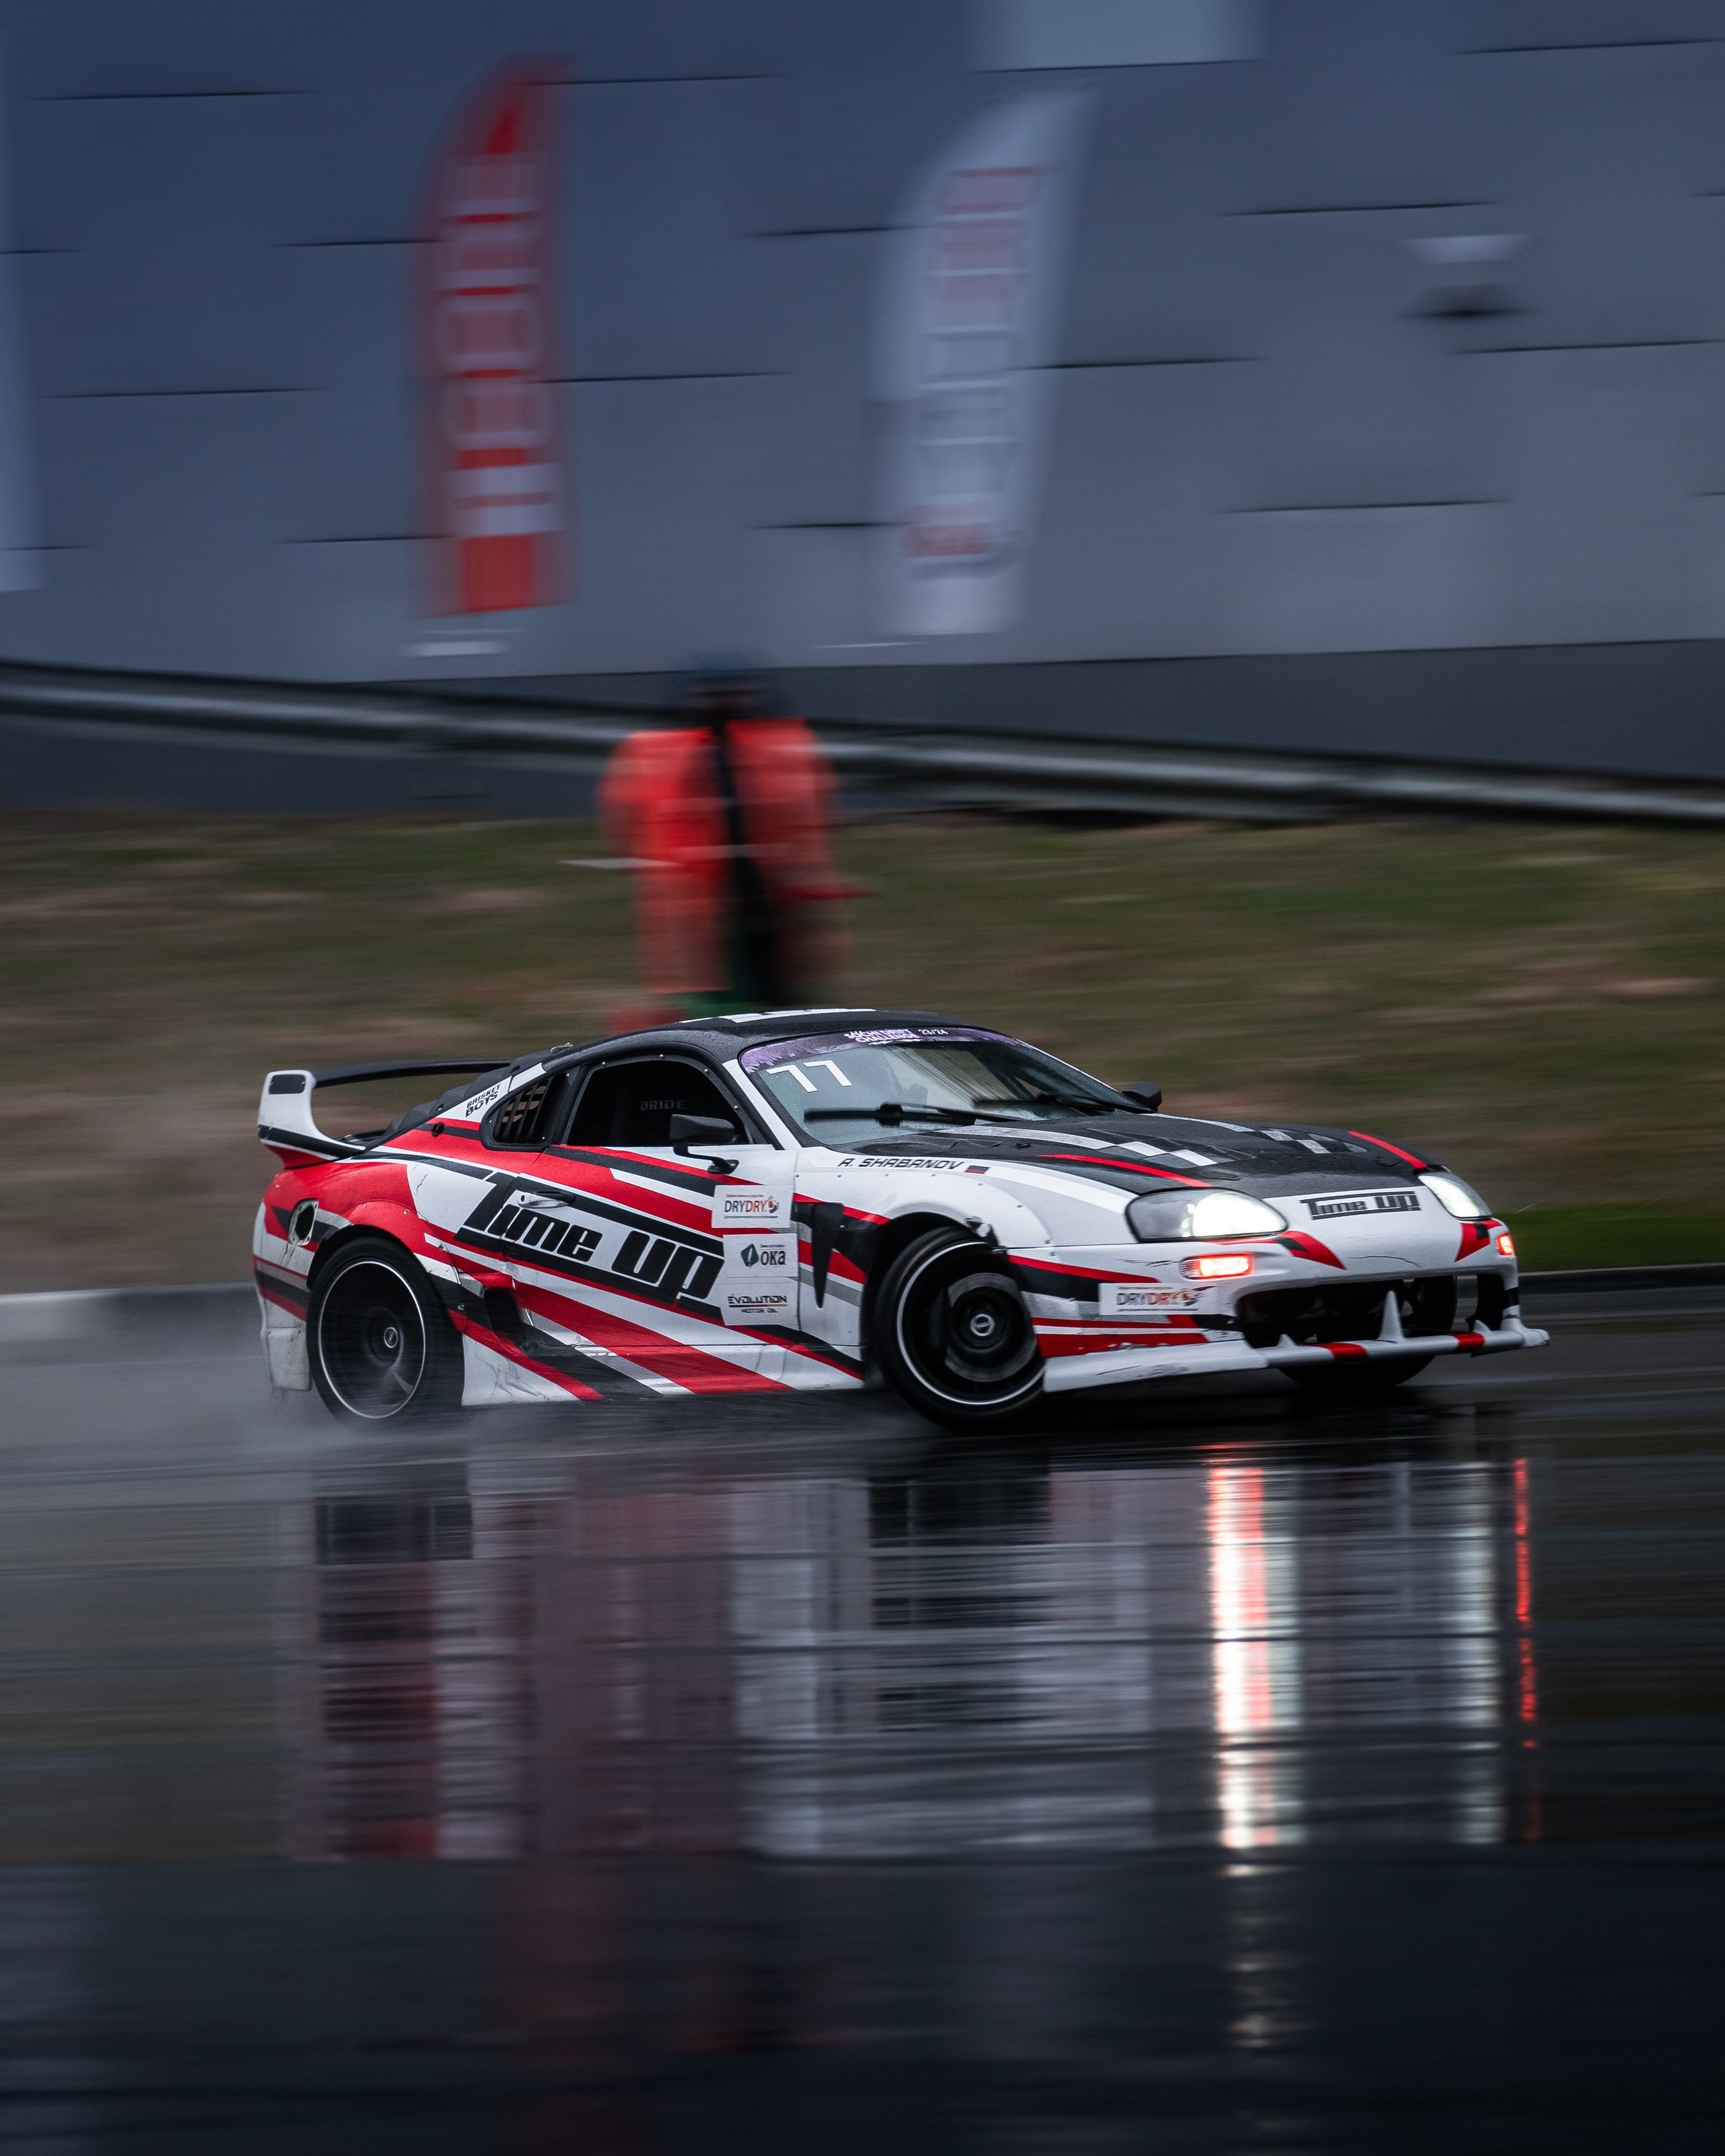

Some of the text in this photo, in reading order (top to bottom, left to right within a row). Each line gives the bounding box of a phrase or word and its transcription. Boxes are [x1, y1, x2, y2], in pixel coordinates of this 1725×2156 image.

[855, 1033, 920, 1042] CHALLENGE
[765, 1060, 853, 1093] 77
[466, 1091, 498, 1117] BOYS
[467, 1084, 500, 1108] BRISKET
[640, 1100, 687, 1111] BRIDE
[858, 1158, 964, 1170] SHABANOV
